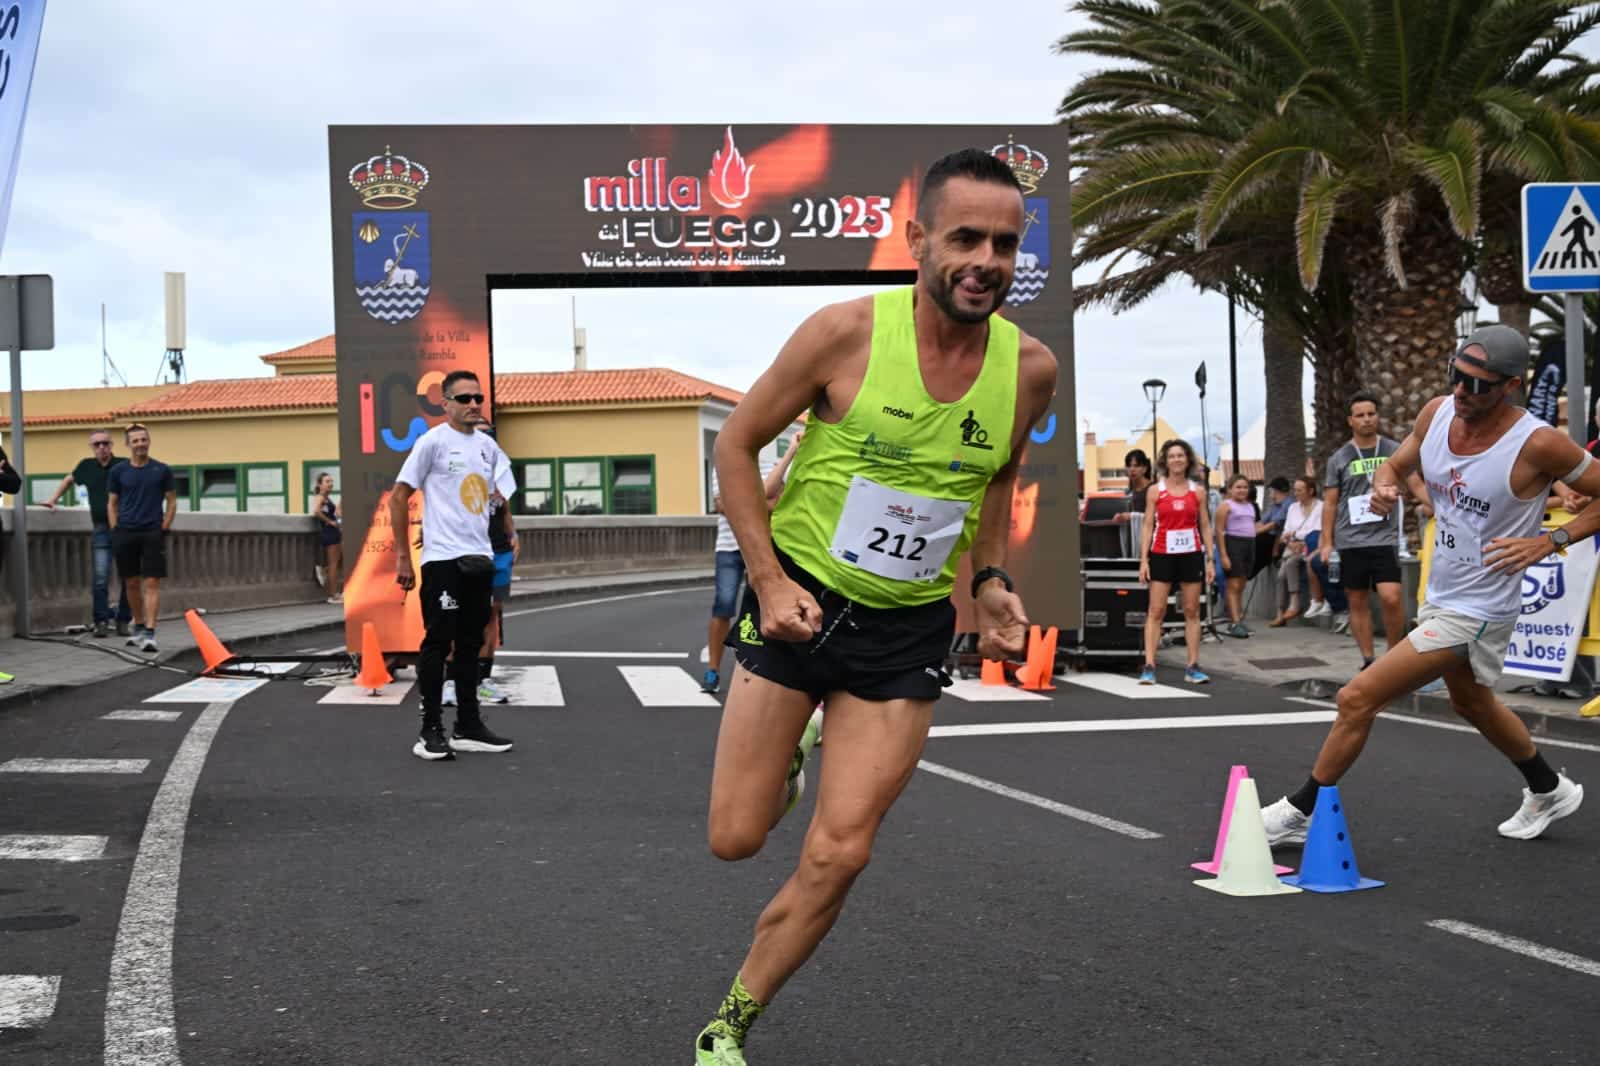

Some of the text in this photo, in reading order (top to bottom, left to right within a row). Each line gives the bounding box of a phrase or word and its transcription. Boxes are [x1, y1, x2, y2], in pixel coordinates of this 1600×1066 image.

[584, 157, 701, 212] milla
[622, 215, 782, 249] FUEGO
[789, 194, 894, 239] 2025
[867, 527, 928, 561] 212
[1513, 620, 1576, 638] epuest
[1523, 639, 1567, 662] José
